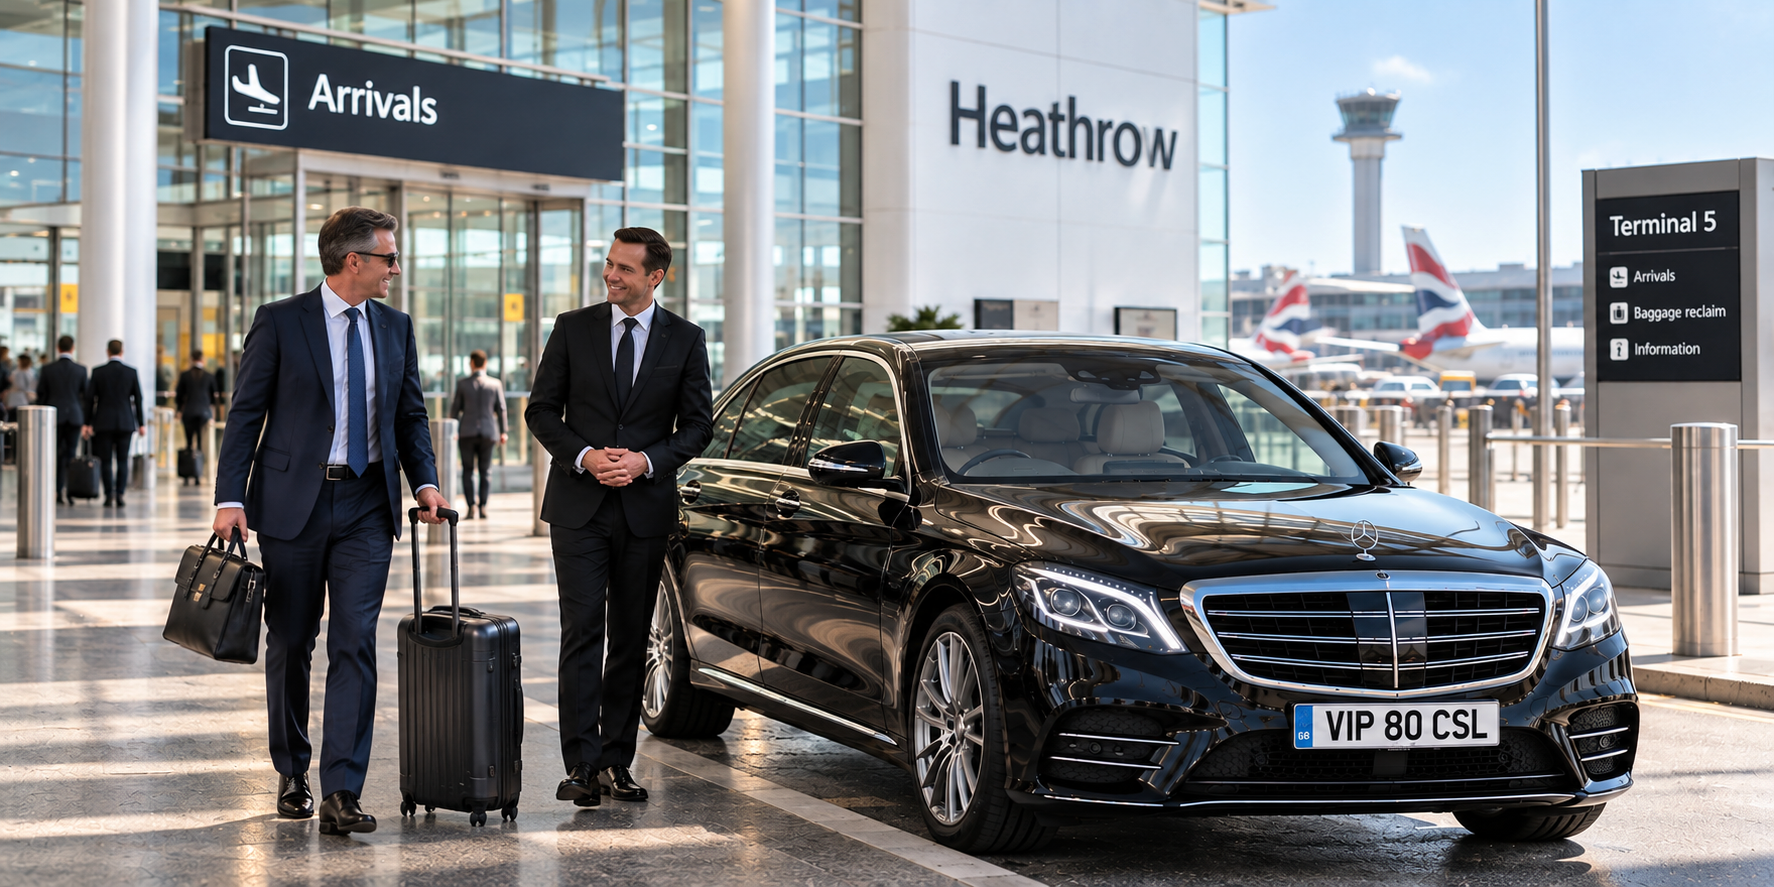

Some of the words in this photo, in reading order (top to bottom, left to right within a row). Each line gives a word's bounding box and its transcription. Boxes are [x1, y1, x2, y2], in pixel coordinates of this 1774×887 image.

[308, 73, 438, 125] Arrivals
[950, 80, 1178, 170] Heathrow
[1609, 210, 1697, 237] Terminal
[1703, 210, 1717, 232] 5
[1633, 268, 1676, 283] Arrivals
[1634, 306, 1682, 322] Baggage
[1685, 304, 1727, 318] reclaim
[1634, 342, 1701, 356] Information
[1325, 710, 1375, 742] VIP
[1384, 709, 1422, 741] 80
[1432, 708, 1488, 740] CSL
